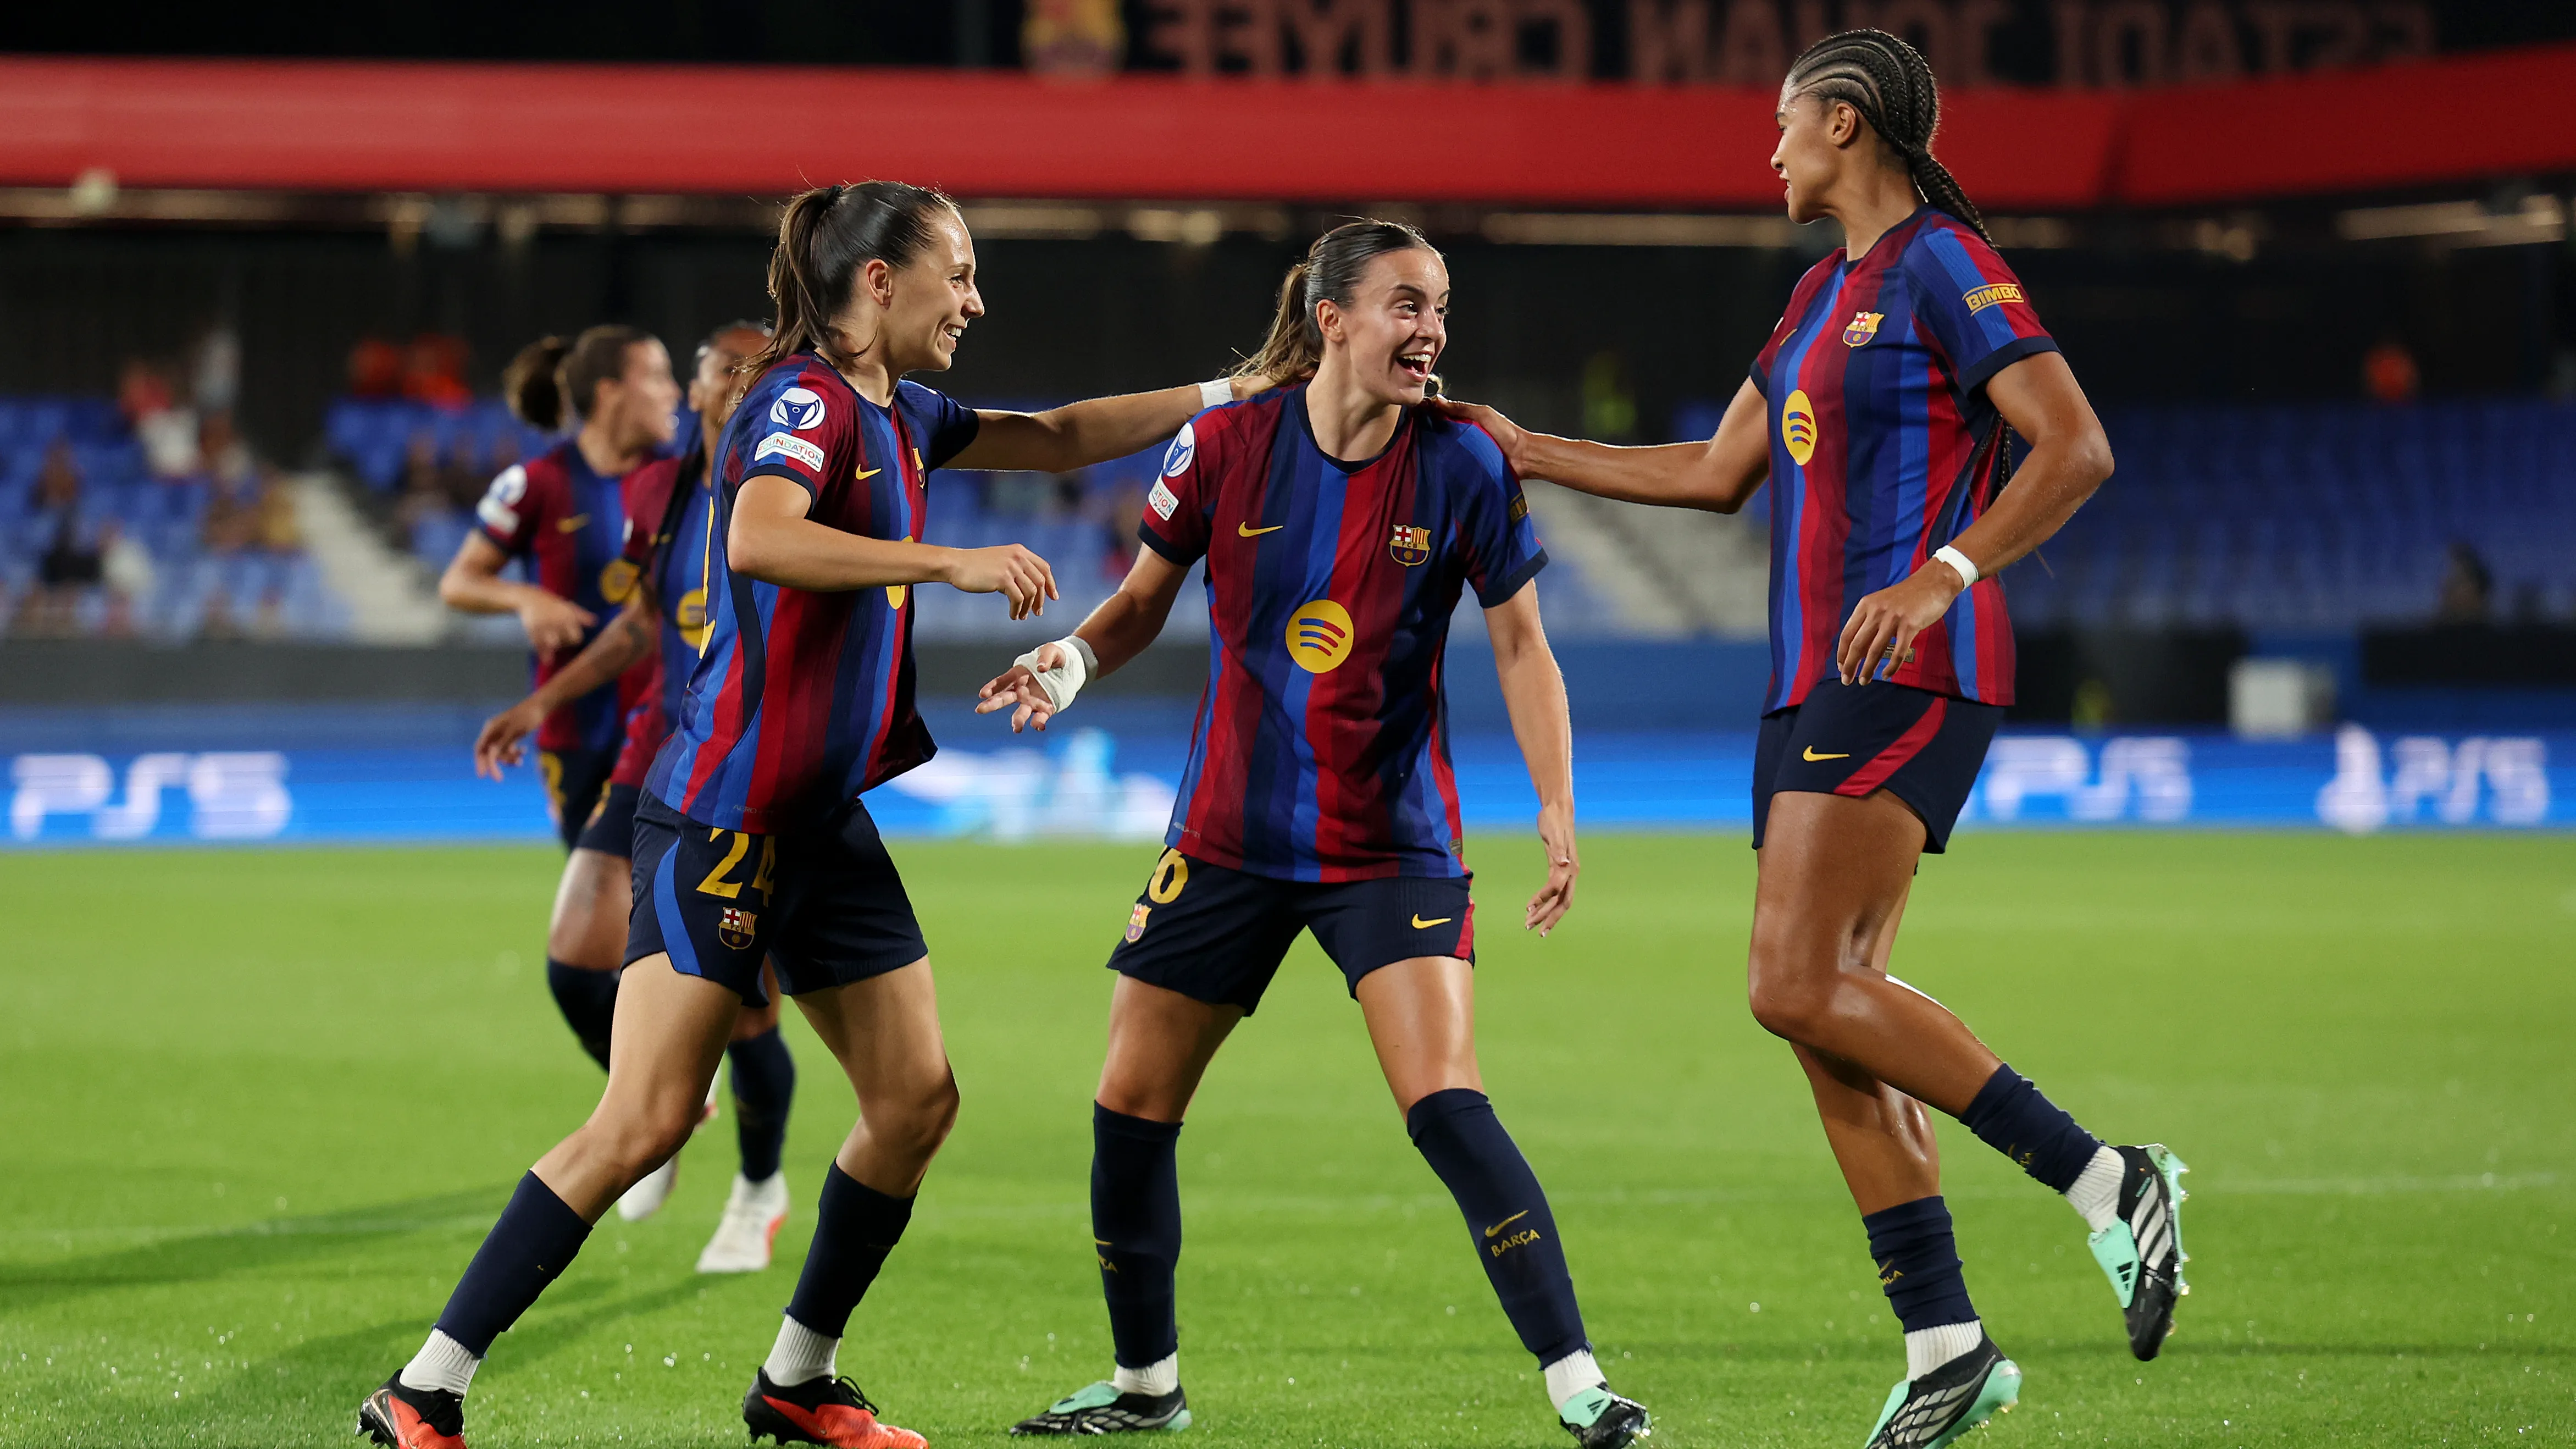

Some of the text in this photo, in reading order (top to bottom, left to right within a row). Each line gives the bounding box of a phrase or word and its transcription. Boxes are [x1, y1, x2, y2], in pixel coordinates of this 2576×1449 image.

[1965, 286, 2022, 311] BIMBO
[758, 438, 822, 464] FOUNDATION
[12, 751, 291, 840] PS5
[2391, 737, 2549, 825] PS5
[696, 827, 775, 908] 24
[1149, 845, 1188, 904] 6
[1491, 1229, 1541, 1258] BARÇA
